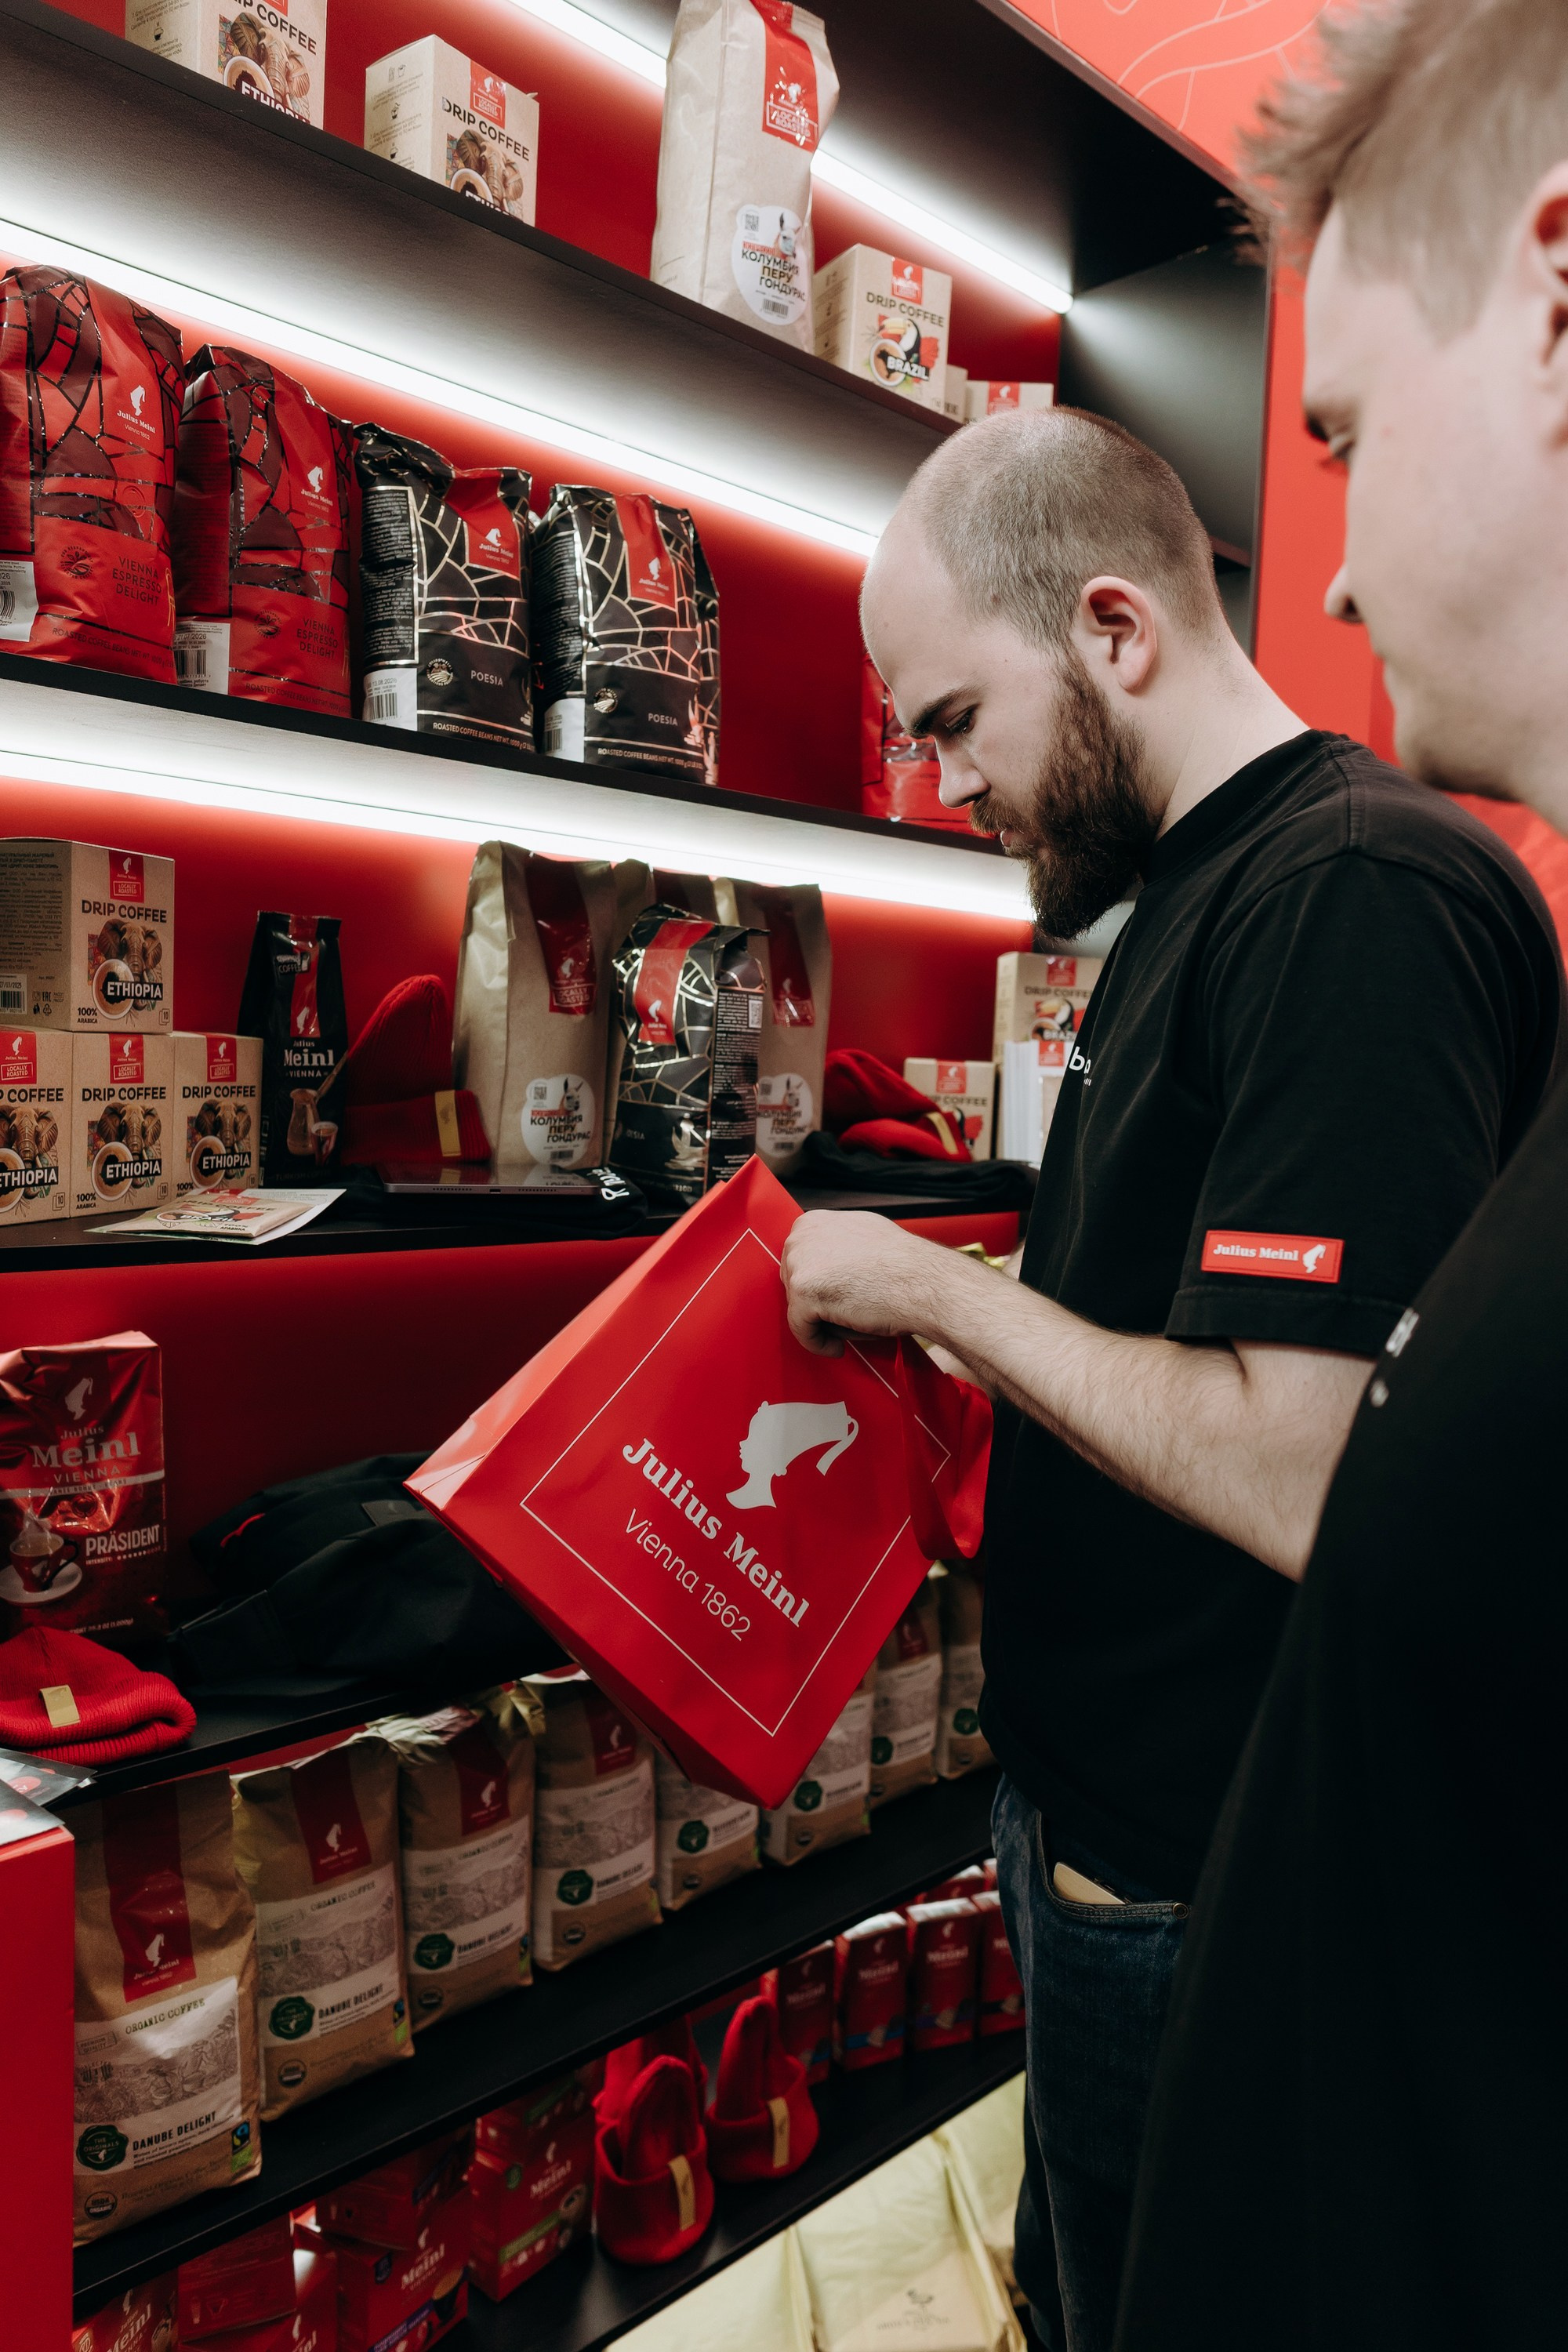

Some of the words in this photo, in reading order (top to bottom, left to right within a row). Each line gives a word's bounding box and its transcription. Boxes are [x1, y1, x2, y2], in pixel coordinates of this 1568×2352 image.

[256, 3, 317, 55] COFFEE
[441, 96, 476, 125] DRIP
[478, 121, 530, 162] COFFEE
[763, 266, 793, 284] ПЕРУ
[866, 292, 896, 308] DRIP
[900, 303, 945, 328] COFFEE
[887, 356, 931, 382] BRAZIL
[117, 410, 138, 424] Julius
[140, 419, 155, 434] Meinl
[125, 423, 140, 435] Vienna
[479, 543, 499, 554] Julius
[118, 556, 159, 579] VIENNA
[112, 568, 162, 594] ESPRESSO
[115, 583, 160, 607] DELIGHT
[303, 618, 335, 636] VIENNA
[52, 626, 87, 643] ROASTED
[88, 633, 111, 651] COFFEE
[296, 628, 339, 649] ESPRESSO
[299, 641, 336, 659] DELIGHT
[470, 669, 504, 688] POESIA
[245, 683, 277, 695] ROASTED
[648, 713, 679, 727] POESIA
[433, 722, 460, 733] ROASTED
[460, 726, 478, 737] COFFEE
[478, 730, 493, 742] BEANS
[597, 747, 623, 757] ROASTED
[623, 750, 643, 760] COFFEE
[82, 899, 115, 916] DRIP
[118, 904, 167, 924] COFFEE
[107, 981, 163, 999] ETHIOPIA
[1024, 985, 1051, 996] DRIP
[1054, 987, 1093, 997] COFFE
[77, 1007, 98, 1017] 100%
[163, 1011, 169, 1020] 10
[284, 1048, 336, 1068] Meinl
[289, 1069, 322, 1078] VIENNA
[7, 1087, 64, 1103] COFFEE
[82, 1087, 115, 1102] DRIP
[118, 1087, 167, 1102] COFFEE
[182, 1086, 212, 1099] DRIP
[213, 1085, 256, 1098] COFFEE
[944, 1097, 988, 1106] COFFEE
[530, 1114, 583, 1126] КОЛУМБИЯ
[549, 1123, 576, 1134] ПЕРУ
[106, 1160, 162, 1178] ETHIOPIA
[202, 1153, 250, 1170] ETHIOPIA
[162, 1186, 167, 1195] 10
[176, 1181, 194, 1192] 100%
[58, 1195, 64, 1205] 10
[76, 1192, 96, 1203] 100%
[1213, 1243, 1257, 1258] Julius
[1258, 1247, 1299, 1261] Meinl
[60, 1426, 105, 1440] Julius
[32, 1432, 142, 1468] Meinl
[53, 1466, 121, 1484] VIENNA
[85, 1524, 160, 1557] PRÄSIDENT
[622, 1437, 722, 1540] Julius
[723, 1532, 810, 1628] Meinl
[626, 1508, 698, 1593] Vienna
[699, 1581, 752, 1642] 1862
[318, 2000, 353, 2020] DANUBE
[354, 1983, 384, 2005] DELIGHT
[125, 2012, 165, 2035] ORGANIC
[167, 1998, 206, 2020] COFFEE
[132, 2125, 174, 2151] DANUBE
[176, 2111, 217, 2137] DELIGHT
[83, 2141, 119, 2153] ORIGINALS
[93, 2136, 107, 2145] THE
[401, 2242, 445, 2290] Meinl
